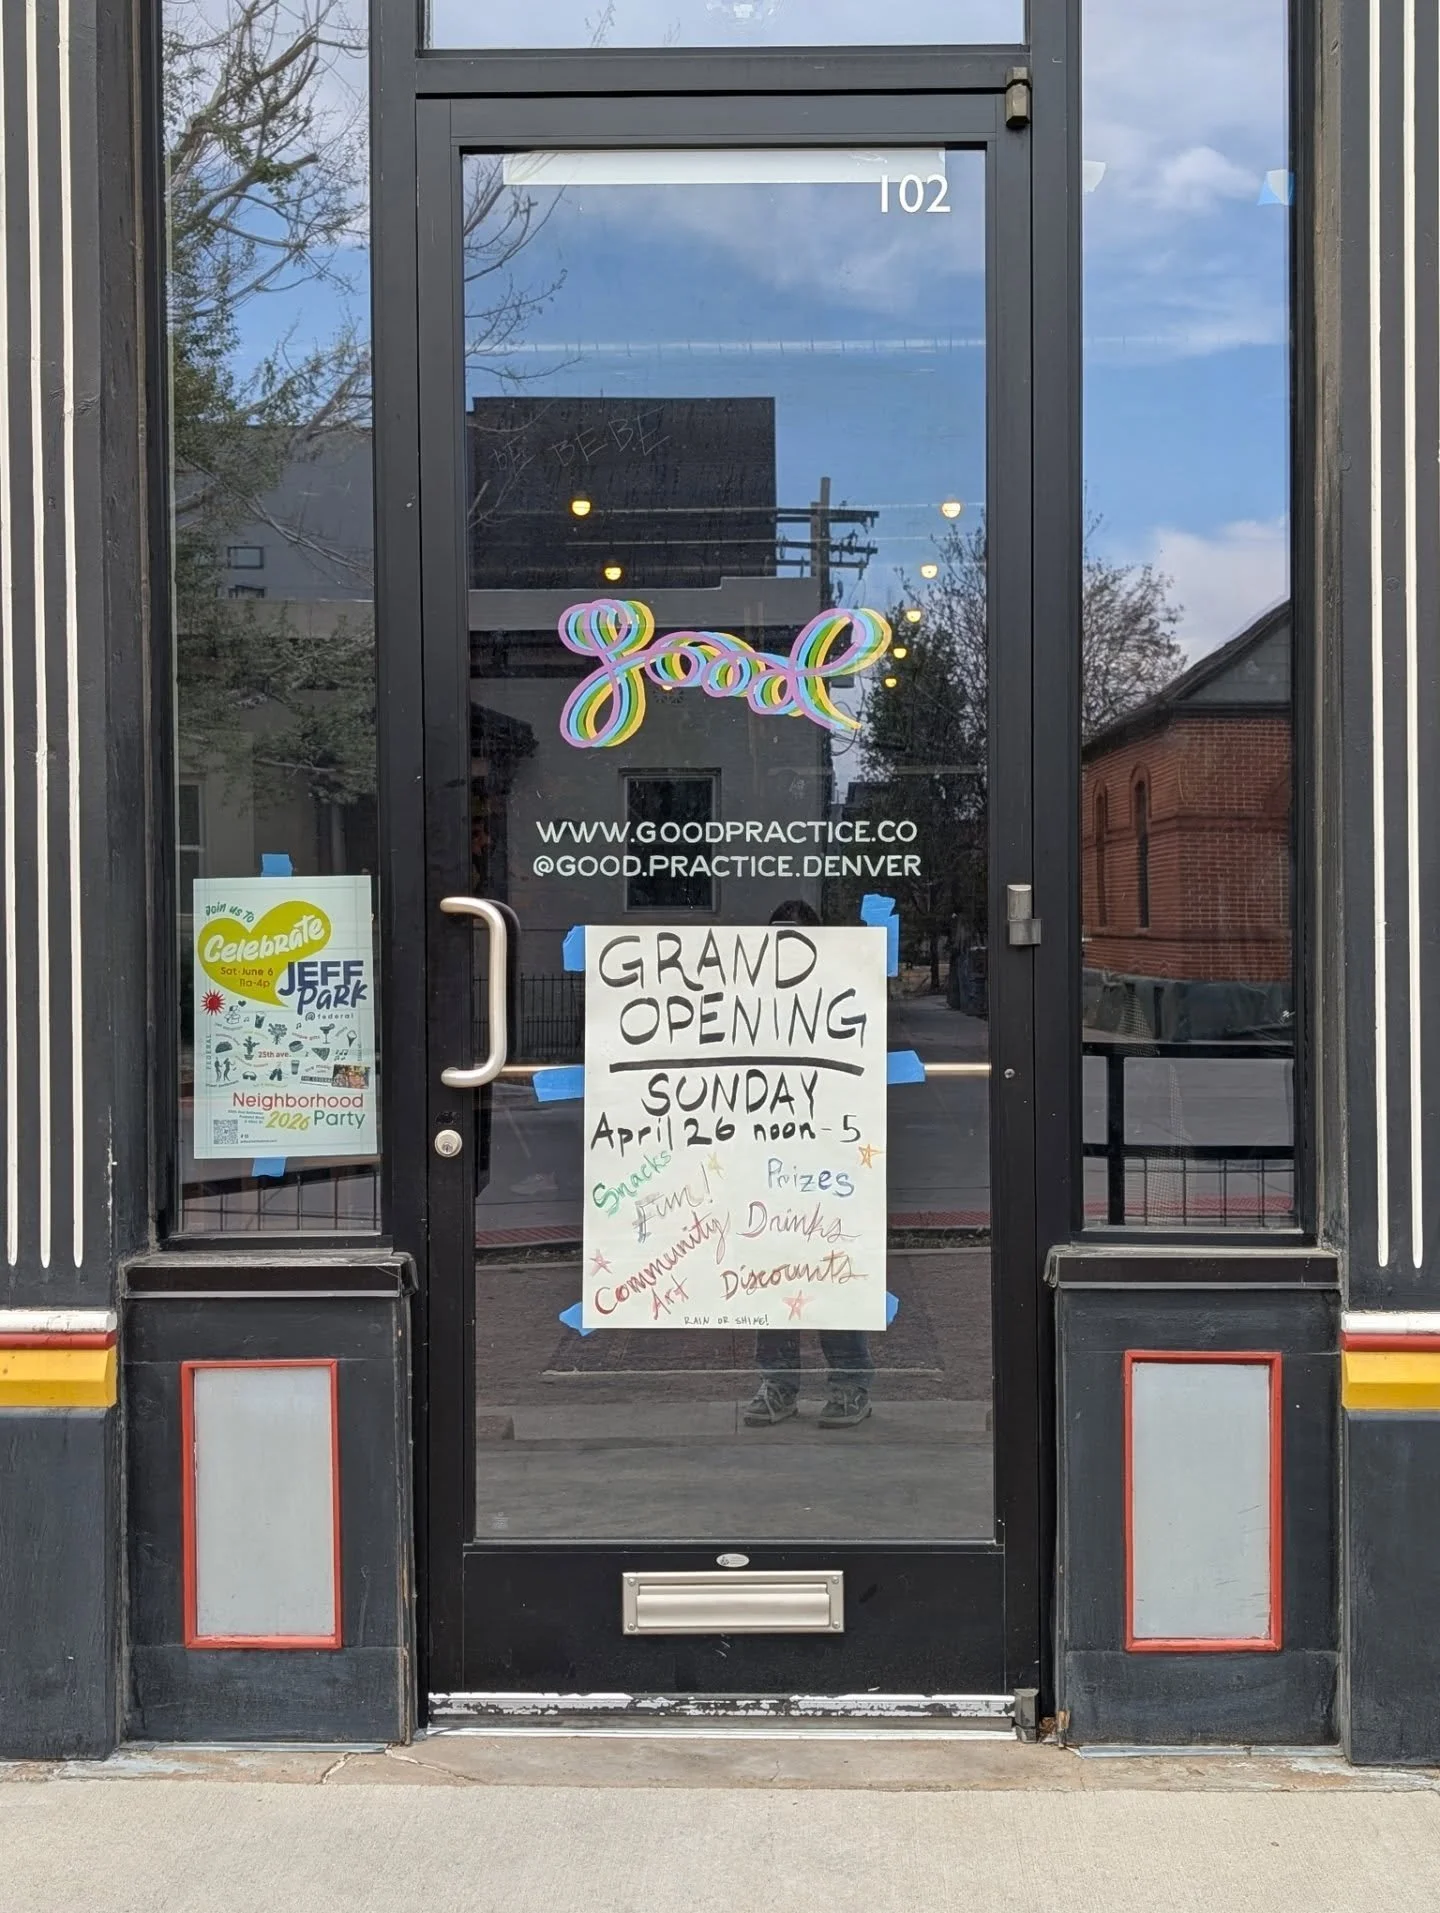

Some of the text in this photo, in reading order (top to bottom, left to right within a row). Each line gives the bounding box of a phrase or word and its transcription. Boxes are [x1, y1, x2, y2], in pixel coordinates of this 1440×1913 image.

[879, 174, 952, 214] 102
[536, 820, 918, 844] WWW.GOODPRACTICE.CO
[533, 855, 922, 878] @GOOD.PRACTICE.DENVER
[205, 902, 227, 916] Join
[229, 904, 243, 917] us
[267, 967, 274, 977] 6
[277, 960, 364, 997] JEFF
[599, 928, 818, 992] GRAND
[619, 987, 867, 1048] OPENING
[232, 1091, 364, 1111] Neighborhood
[641, 1068, 819, 1119] SUNDAY
[265, 1110, 312, 1131] 2026
[313, 1109, 366, 1130] Party
[590, 1111, 673, 1158] April
[684, 1115, 736, 1147] 26
[592, 1149, 672, 1218] Snacks
[767, 1157, 855, 1198] Prizes
[632, 1161, 714, 1244] Fun!
[736, 1200, 863, 1243] Drinks
[595, 1211, 730, 1315] Community
[720, 1249, 870, 1300] Discounts
[652, 1274, 690, 1321] Art
[684, 1316, 710, 1326] RAIN
[717, 1315, 730, 1325] OR
